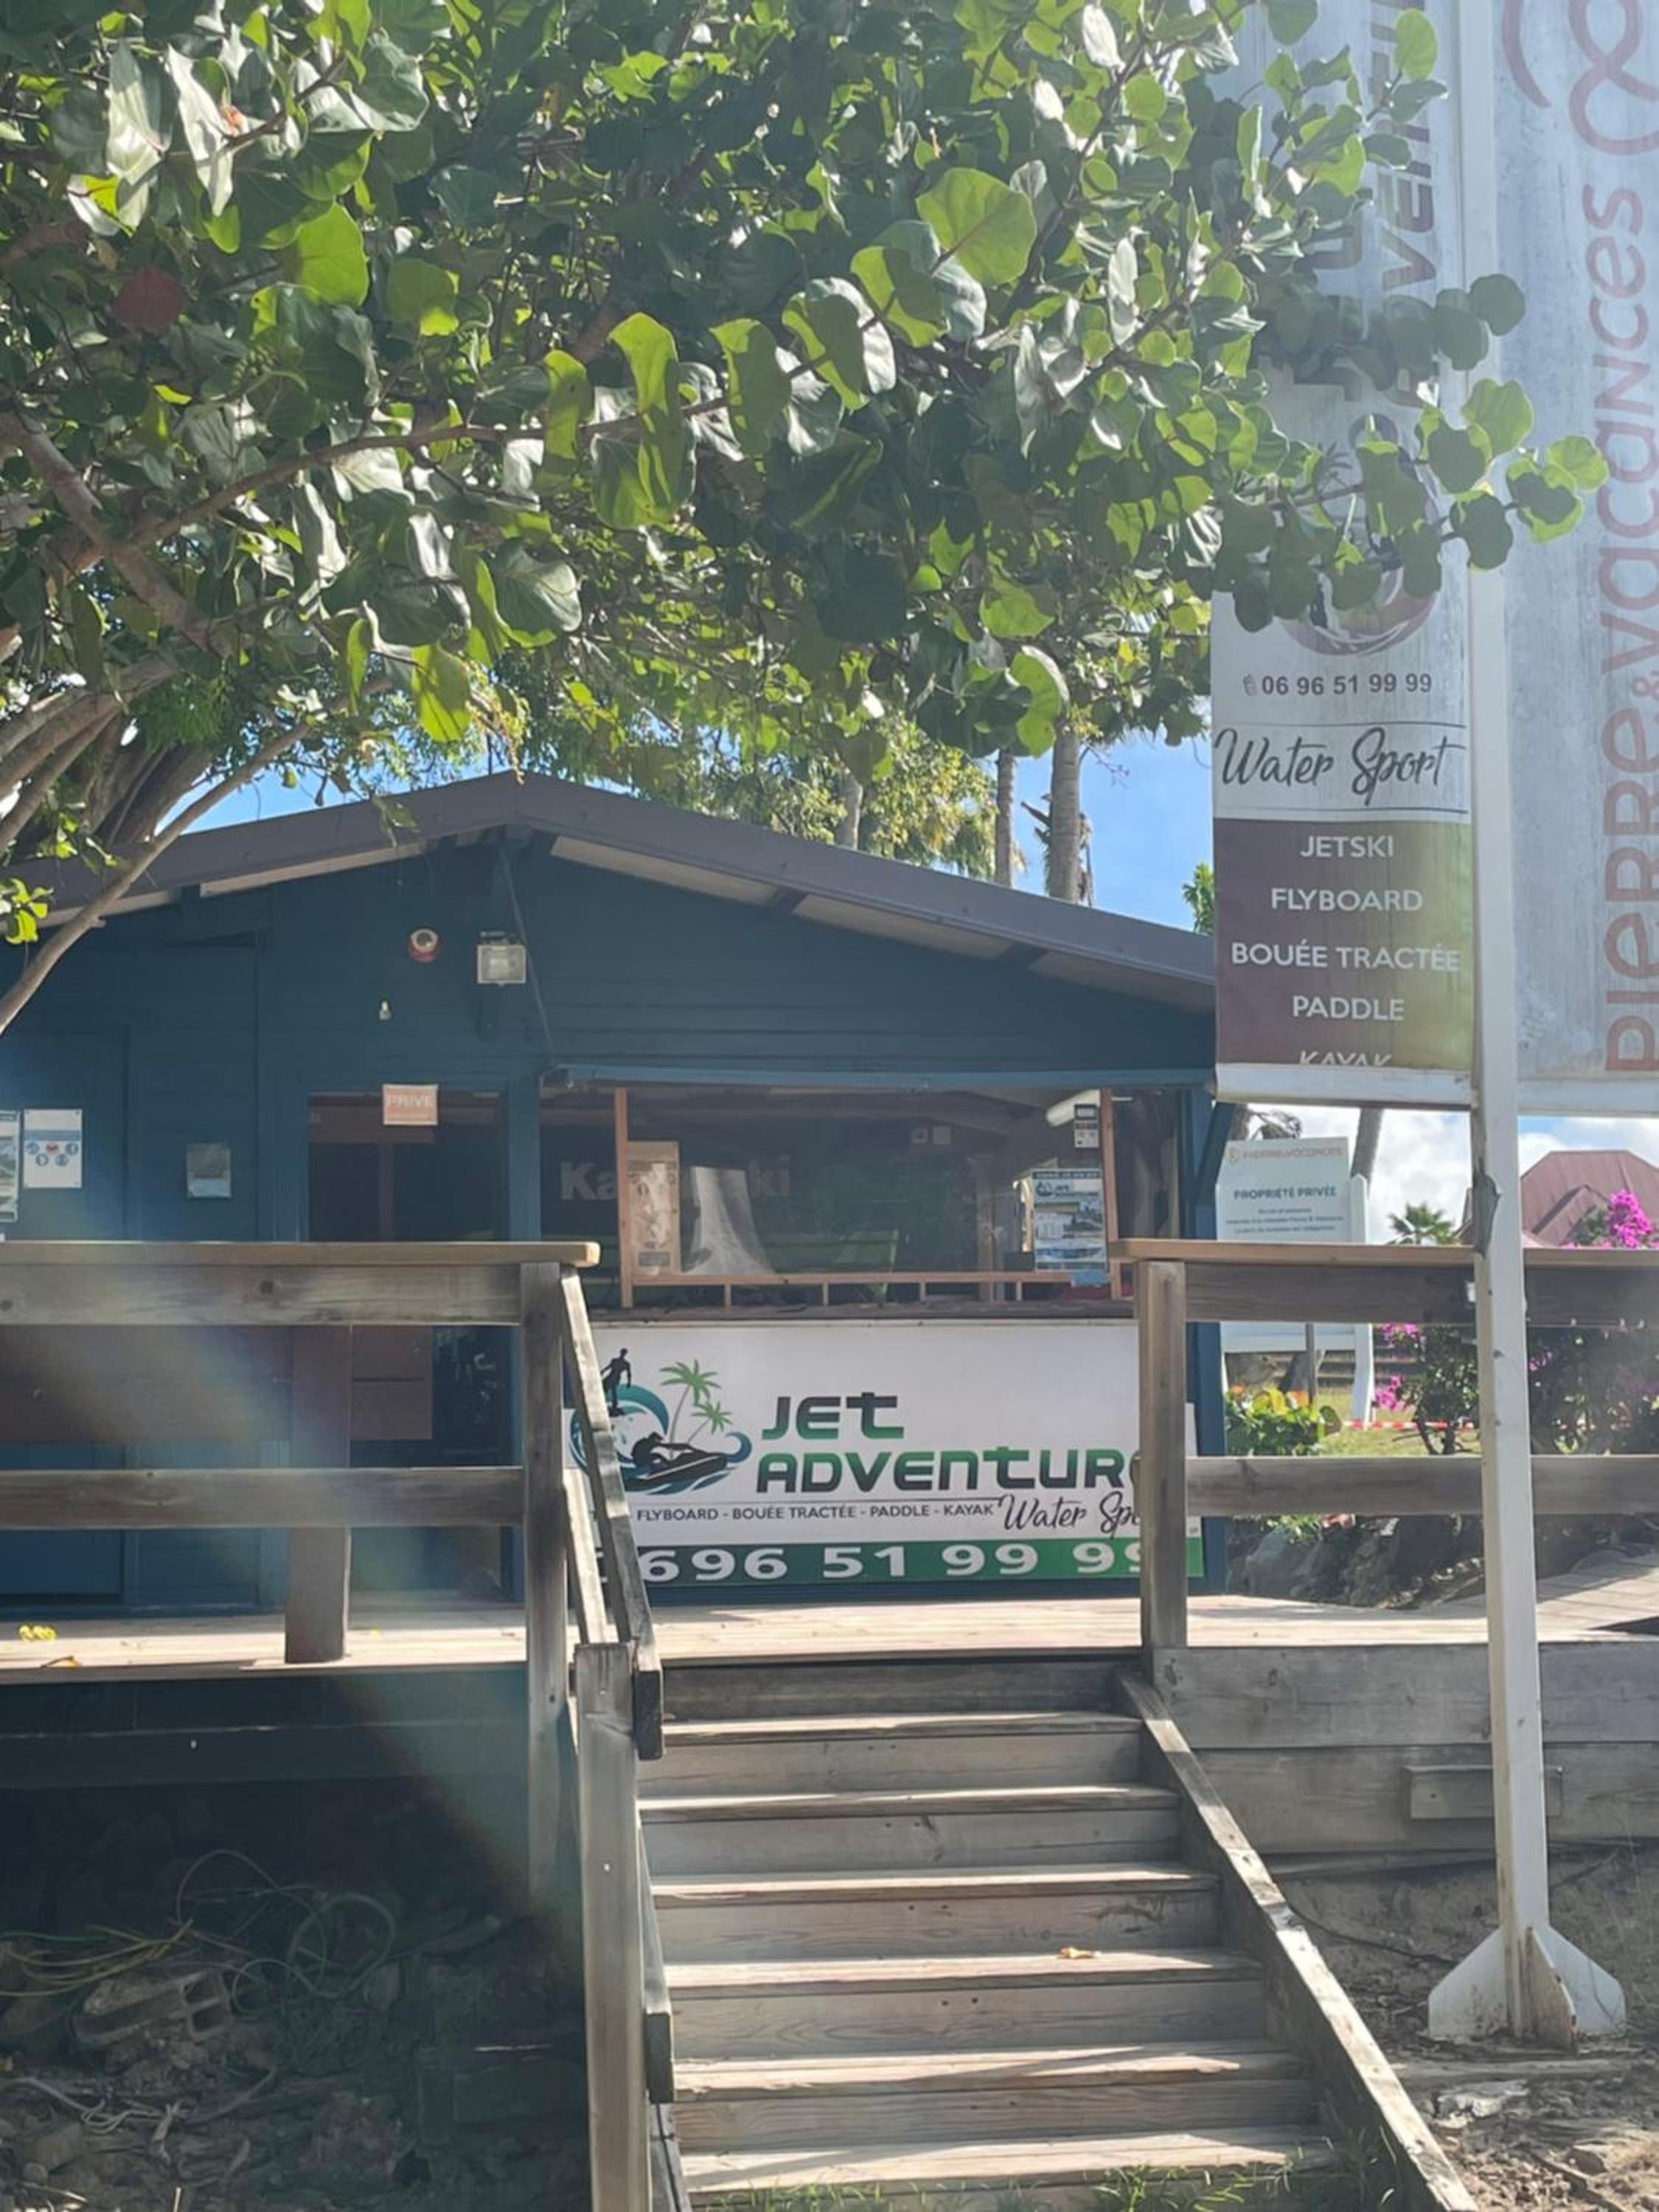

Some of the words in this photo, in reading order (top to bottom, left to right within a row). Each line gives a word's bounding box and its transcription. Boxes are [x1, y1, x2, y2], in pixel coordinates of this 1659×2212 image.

[1262, 675, 1289, 695] 06
[1297, 677, 1324, 695] 96
[1333, 675, 1358, 695] 51
[1369, 673, 1397, 693] 99
[1405, 672, 1432, 693] 99
[1214, 728, 1334, 787] Water
[1352, 726, 1467, 807] Sport
[1300, 835, 1394, 858] JETSKI
[1271, 888, 1423, 911] FLYBOARD
[1231, 939, 1328, 967] BOUÉE
[1335, 944, 1461, 972] TRACTÉE
[1293, 995, 1405, 1021] PADDLE
[636, 1509, 719, 1522] FLYBOARD
[732, 1504, 784, 1520] BOUÉE
[790, 1503, 856, 1519] TRACTÉE
[870, 1505, 930, 1517] PADDLE
[944, 1503, 995, 1517] KAYAK
[998, 1493, 1087, 1531] Water
[823, 1545, 905, 1579] 51
[942, 1543, 1039, 1576] 99
